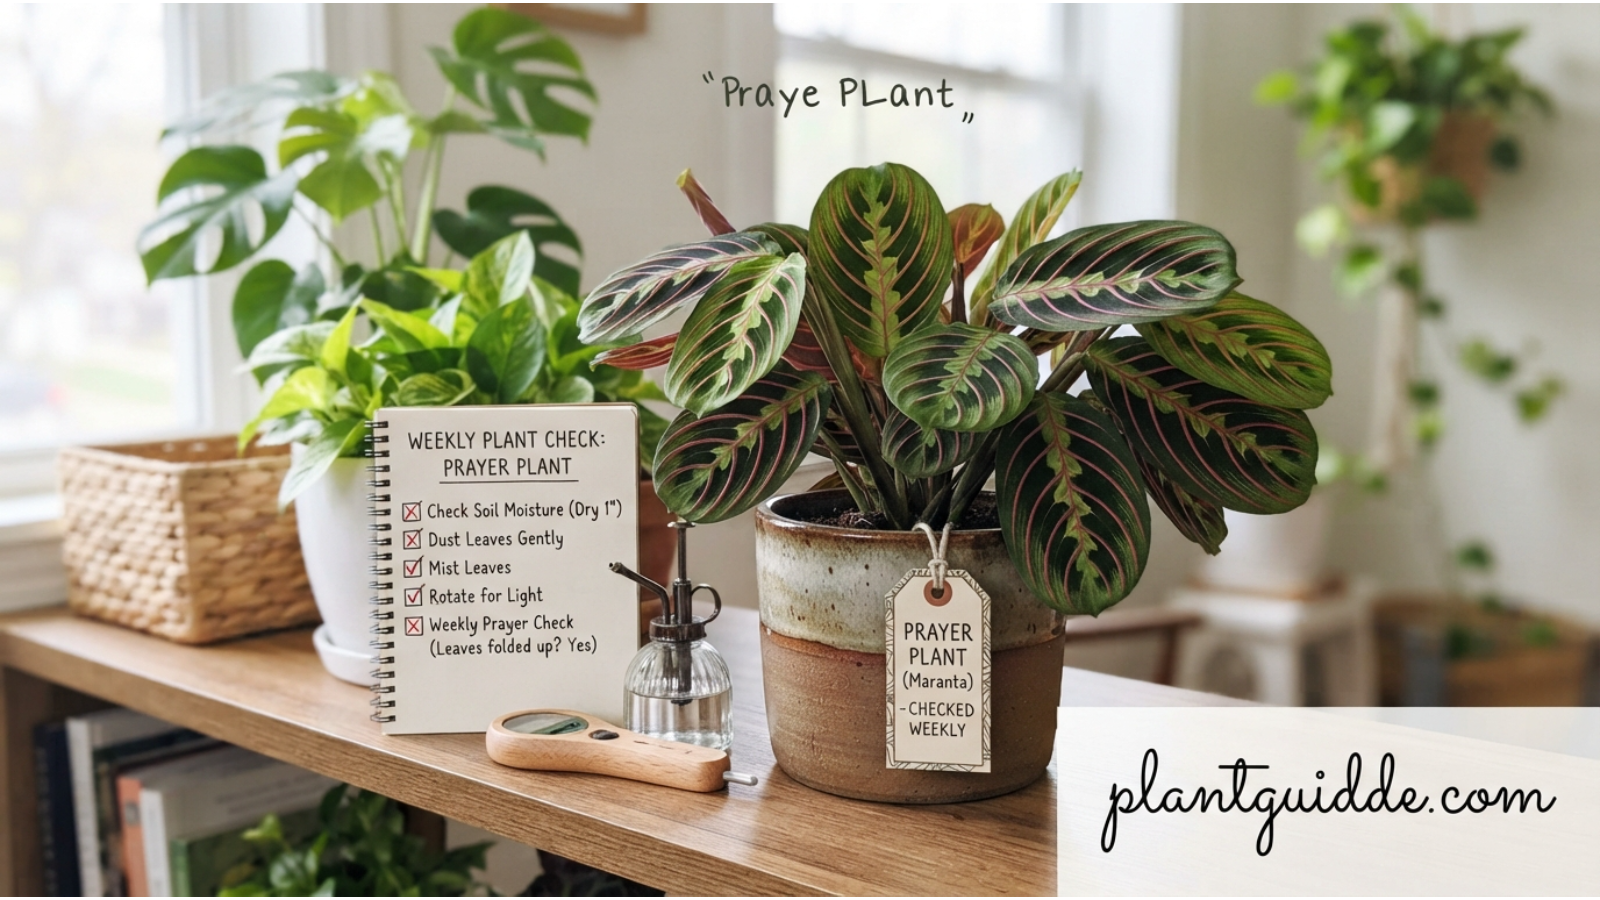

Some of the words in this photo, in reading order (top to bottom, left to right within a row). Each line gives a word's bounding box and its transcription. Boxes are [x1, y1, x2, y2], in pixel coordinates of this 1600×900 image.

[408, 432, 475, 449] WEEKLY
[483, 431, 537, 449] PLANT
[545, 430, 605, 448] CHECK:
[444, 458, 509, 477] PRAYER
[517, 457, 572, 475] PLANT
[428, 503, 468, 519] Check
[474, 502, 499, 518] Soil
[505, 502, 563, 517] Moisture
[569, 500, 598, 521] (Dry
[429, 532, 460, 547] Dust
[466, 531, 512, 546] Leaves
[518, 529, 563, 550] Gently
[429, 560, 459, 576] Mist
[465, 560, 511, 575] Leaves
[430, 589, 475, 605] Rotate
[481, 587, 502, 602] for
[508, 586, 543, 607] Light
[429, 616, 478, 637] Weekly
[483, 616, 528, 635] Prayer
[534, 614, 573, 629] Check
[905, 622, 973, 641] PRAYER
[430, 639, 482, 658] (Leaves
[488, 637, 531, 654] folded
[537, 636, 561, 658] up?
[568, 635, 597, 654] Yes)
[910, 647, 967, 666] PLANT
[903, 671, 973, 691] (Maranta)
[909, 722, 965, 737] WEEKLY
